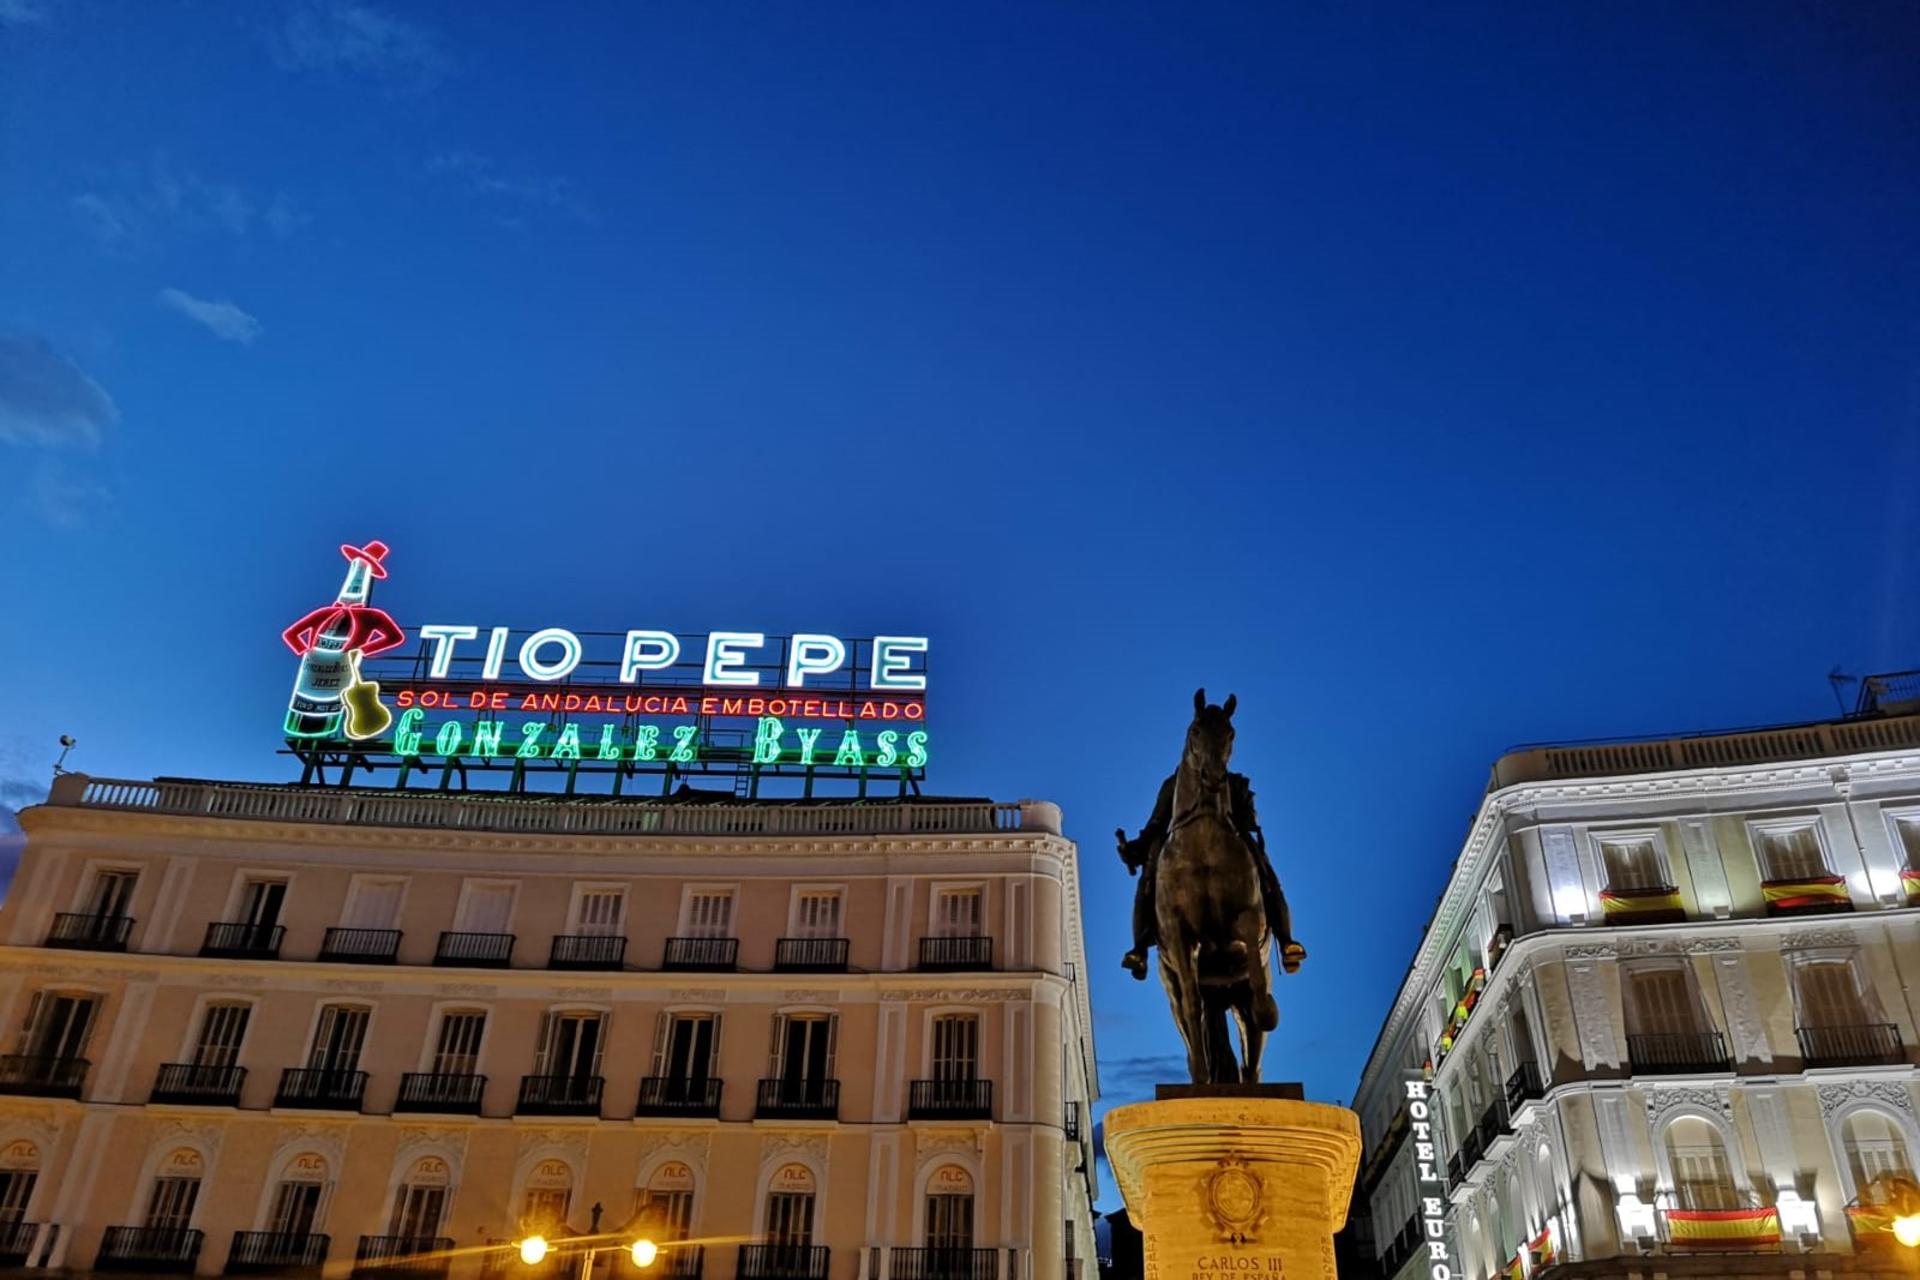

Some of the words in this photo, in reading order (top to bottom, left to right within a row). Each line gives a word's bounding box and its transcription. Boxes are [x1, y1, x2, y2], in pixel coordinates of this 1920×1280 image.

[419, 625, 582, 681] TIO
[619, 630, 928, 690] PEPE
[397, 690, 458, 708] SOL
[470, 691, 510, 709] DE
[520, 693, 688, 713] ANDALUCIA
[702, 697, 922, 719] EMBOTELLADO
[394, 708, 697, 762] GONZALEZ
[753, 716, 928, 767] BYASS
[1405, 1081, 1437, 1181] HOTEL
[1423, 1197, 1450, 1280] EURO
[1198, 1256, 1260, 1270] CARLOS
[1268, 1257, 1283, 1271] III
